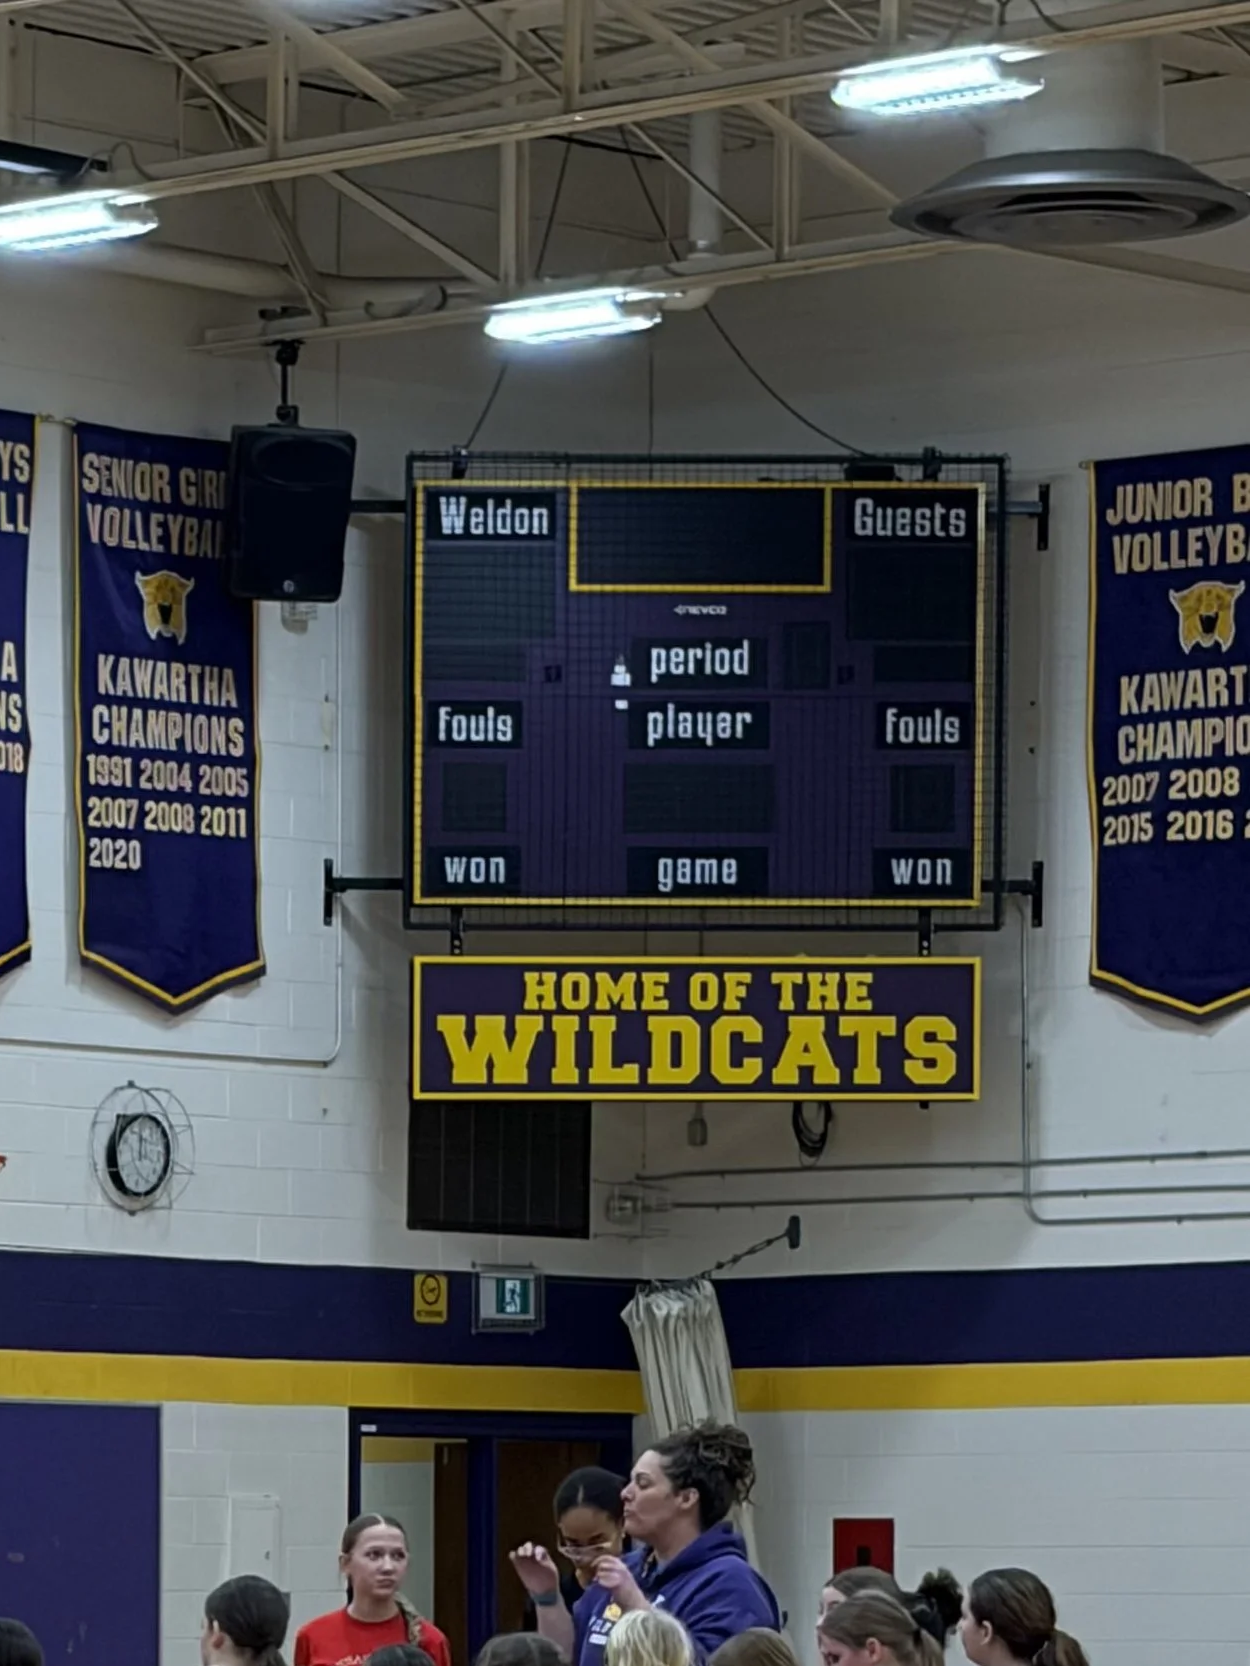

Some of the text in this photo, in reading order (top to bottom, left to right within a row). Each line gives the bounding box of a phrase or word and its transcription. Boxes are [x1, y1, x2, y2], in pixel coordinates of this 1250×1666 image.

[81, 452, 172, 504] SENIOR
[438, 495, 550, 536] Weldon
[853, 497, 968, 539] Guests
[1106, 476, 1214, 527] JUNIOR
[1112, 523, 1250, 576] VOLLEYB
[97, 653, 238, 709] KAWARTHA
[649, 639, 750, 685] period
[1119, 664, 1250, 717] KAWART
[91, 703, 245, 758] CHAMPIONS
[647, 702, 752, 747] player
[86, 753, 249, 798] 1991 2004 2005
[1102, 766, 1240, 808] 2007 2008
[87, 796, 248, 839] 2007 2008 2011
[1102, 813, 1154, 847] 2015
[1166, 808, 1235, 842] 2016
[88, 837, 142, 871] 2020
[443, 855, 506, 885] won
[658, 855, 738, 893] game
[891, 856, 953, 886] won
[522, 971, 874, 1011] HOME OF THE
[436, 1014, 958, 1086] WILDCATS
